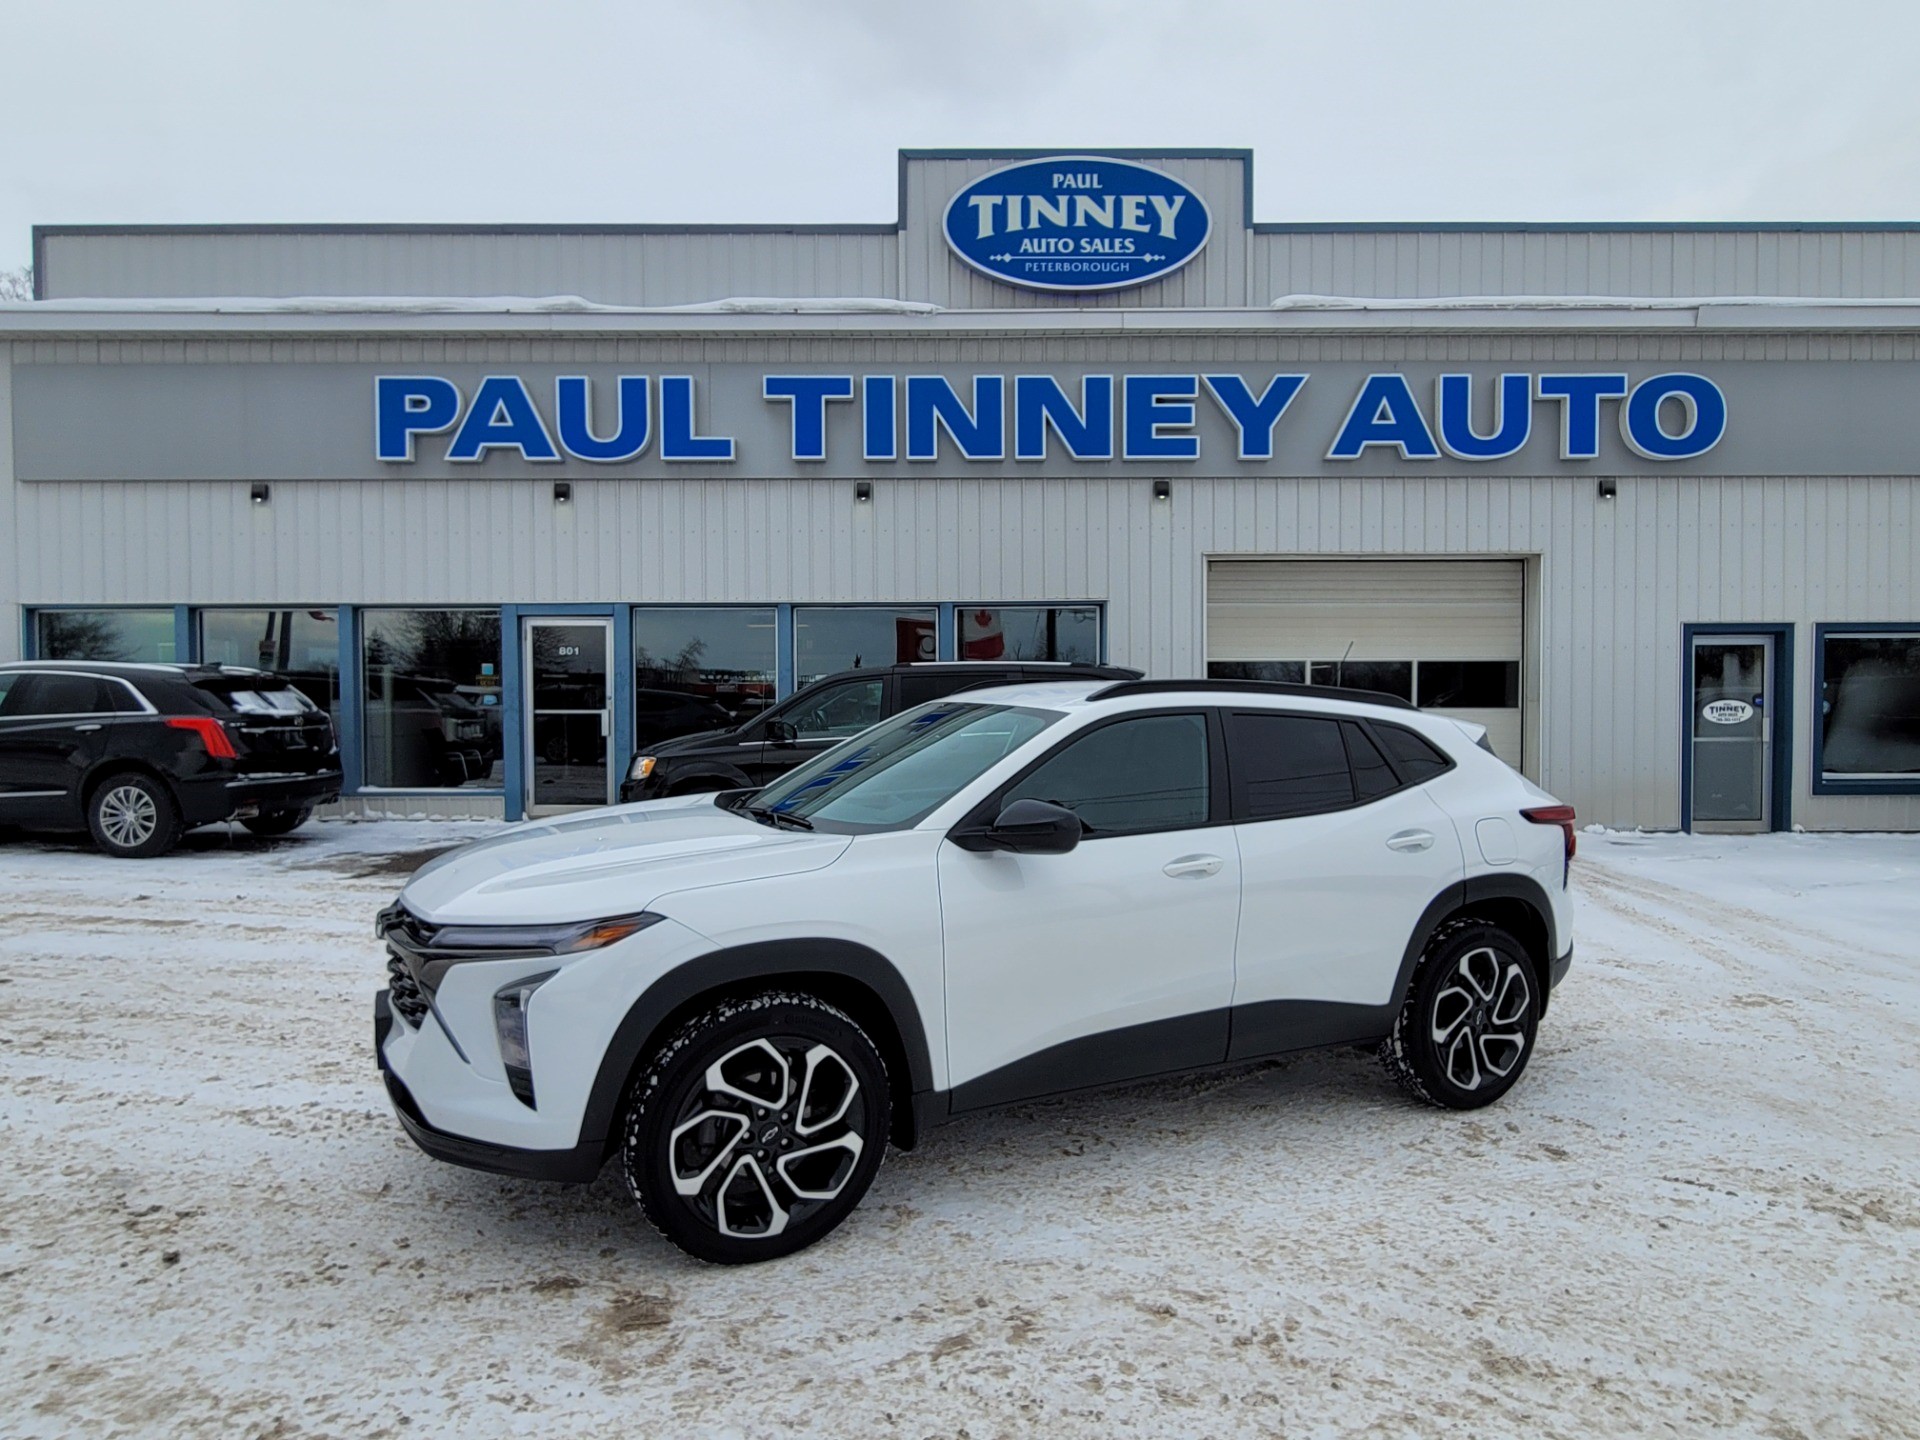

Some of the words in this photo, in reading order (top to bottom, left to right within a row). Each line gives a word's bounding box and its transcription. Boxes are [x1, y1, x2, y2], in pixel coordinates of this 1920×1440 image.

[1052, 173, 1103, 189] PAUL
[968, 195, 1186, 240] TINNEY
[1019, 238, 1075, 253] AUTO
[1079, 238, 1136, 253] SALES
[1024, 261, 1130, 272] PETERBOROUGH
[375, 375, 736, 461] PAUL
[763, 374, 1311, 461] TINNEY
[1324, 372, 1728, 461] AUTO
[558, 646, 579, 656] 801
[1709, 705, 1747, 715] TINNEY
